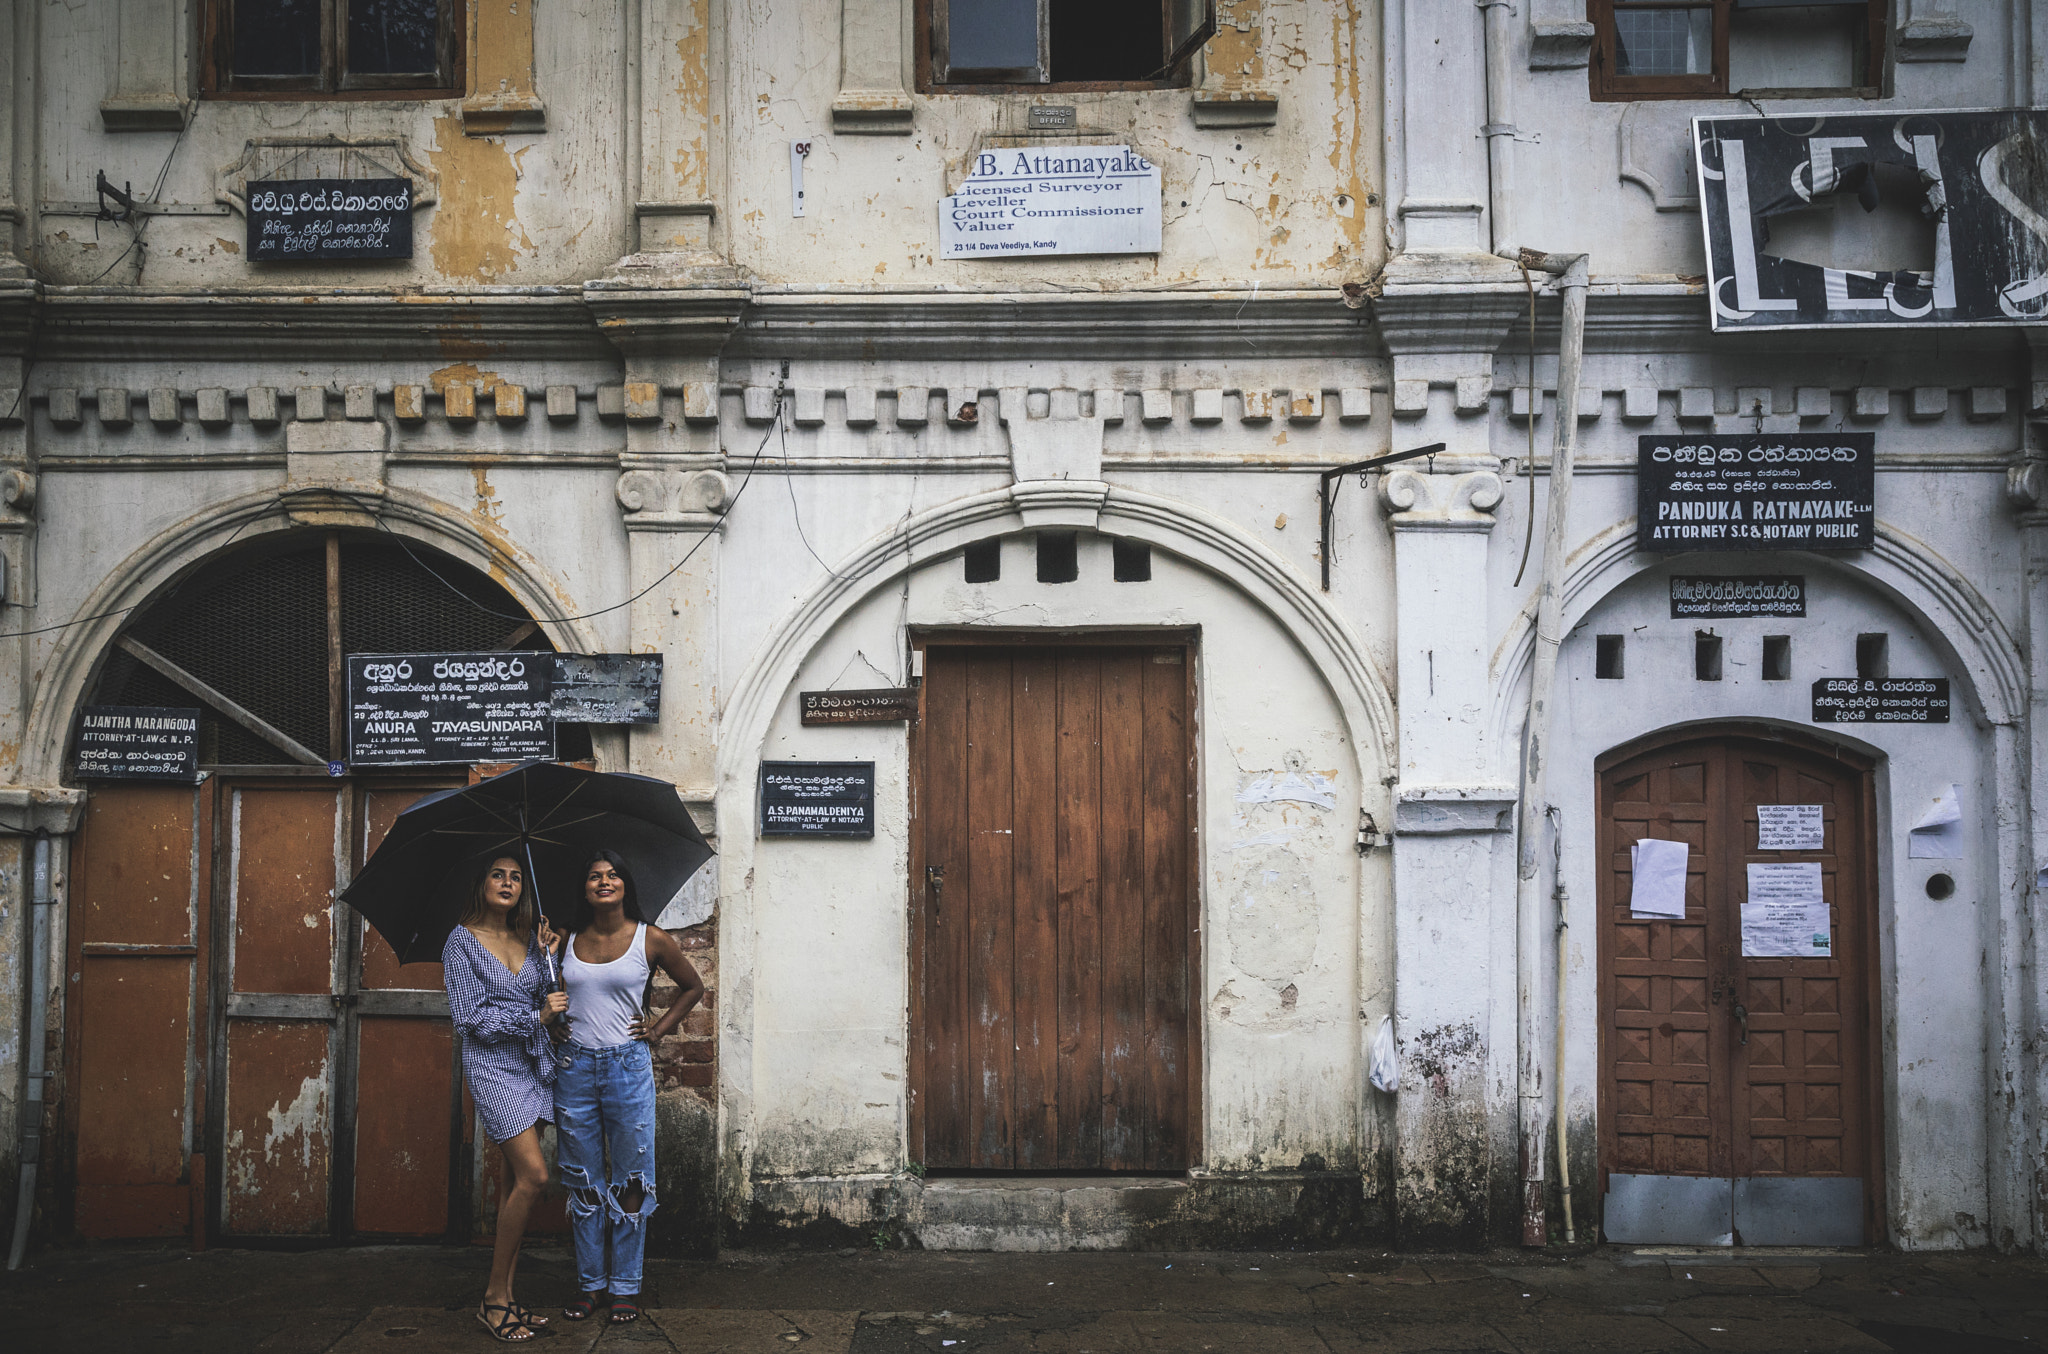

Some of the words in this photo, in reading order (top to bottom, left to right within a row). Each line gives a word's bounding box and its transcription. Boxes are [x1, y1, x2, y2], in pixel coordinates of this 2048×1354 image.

[1011, 150, 1152, 179] Attanayake
[1038, 182, 1123, 194] Surveyor
[951, 196, 1027, 208] Leveller
[952, 208, 1005, 220] Court
[1011, 206, 1144, 218] Commissioner
[952, 221, 1015, 232] Valuer
[954, 243, 964, 251] 23
[966, 243, 976, 252] 1/4
[980, 242, 999, 250] Deva
[1000, 241, 1032, 250] Veediya,
[1033, 240, 1058, 250] Kandy
[1658, 500, 1743, 521] PANDUKA
[1752, 500, 1854, 520] RATNAYAKE
[1653, 524, 1728, 539] ATTORNEY
[1762, 524, 1812, 539] NOTARY
[1815, 523, 1859, 538] PUBLIC
[363, 660, 413, 682] අනුර
[432, 657, 526, 681] ජයසුන්දර
[1827, 680, 1858, 694] සිසිල්
[1882, 680, 1936, 692] රාජරත්න
[83, 715, 132, 729] AJANTHA
[134, 716, 196, 731] NARANGODA
[364, 722, 416, 734] ANURA
[431, 720, 544, 734] JAYASUNDARA
[330, 764, 342, 773] 29
